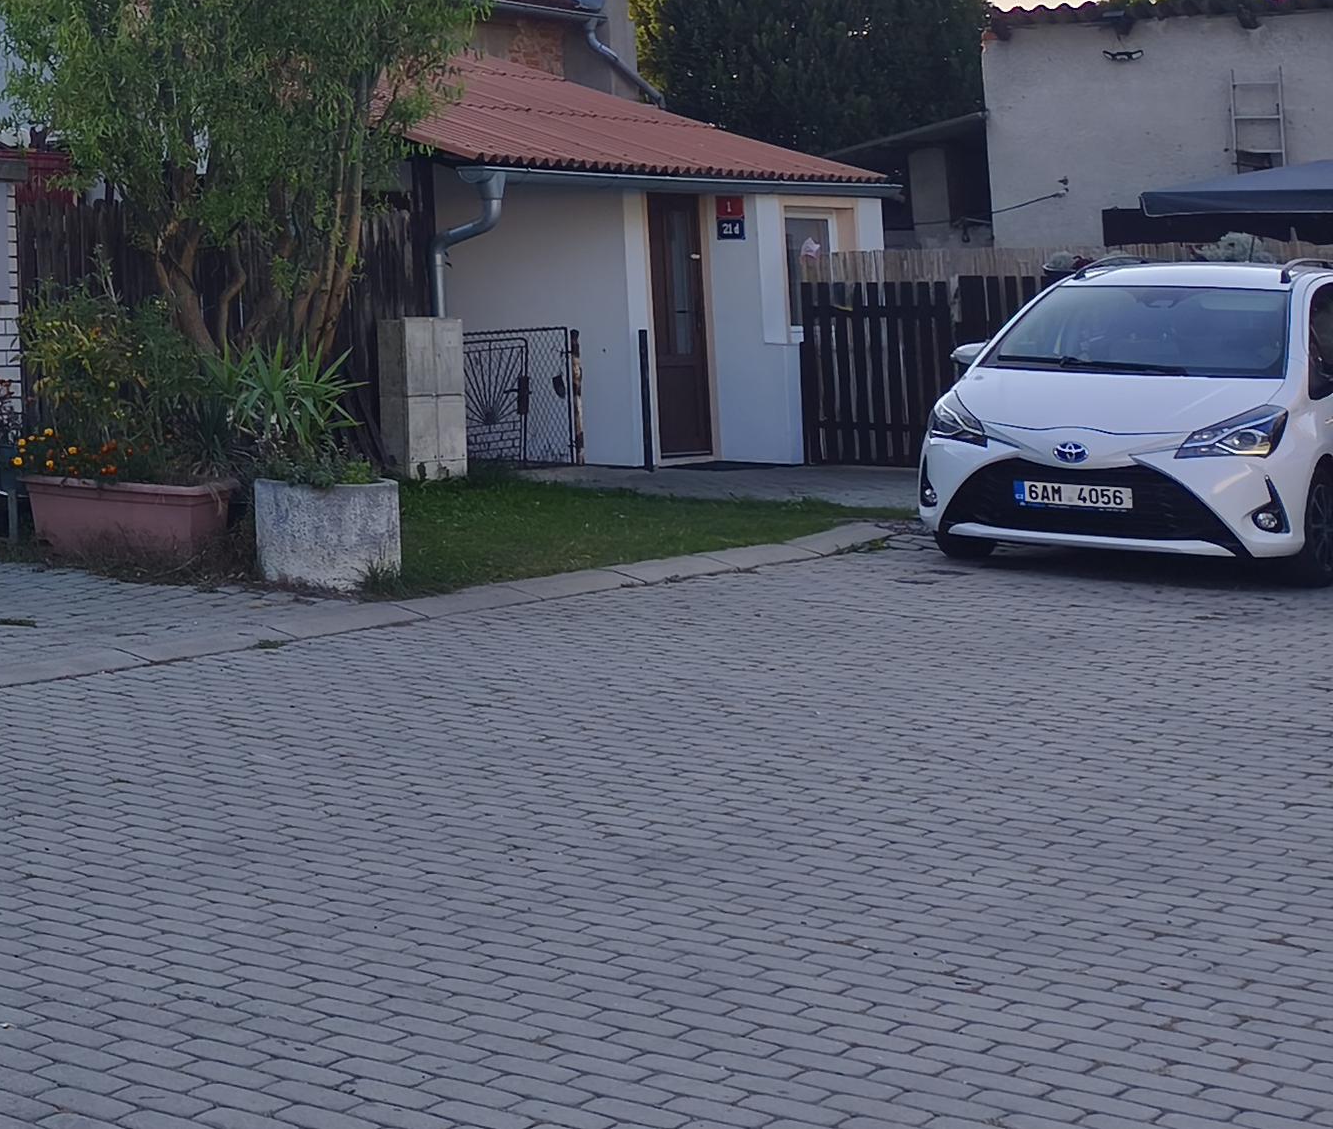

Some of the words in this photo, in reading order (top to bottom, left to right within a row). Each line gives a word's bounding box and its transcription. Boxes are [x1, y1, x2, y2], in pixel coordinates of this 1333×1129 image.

[726, 201, 732, 213] 1
[1028, 484, 1062, 502] 6AM
[1077, 487, 1124, 506] 4056
